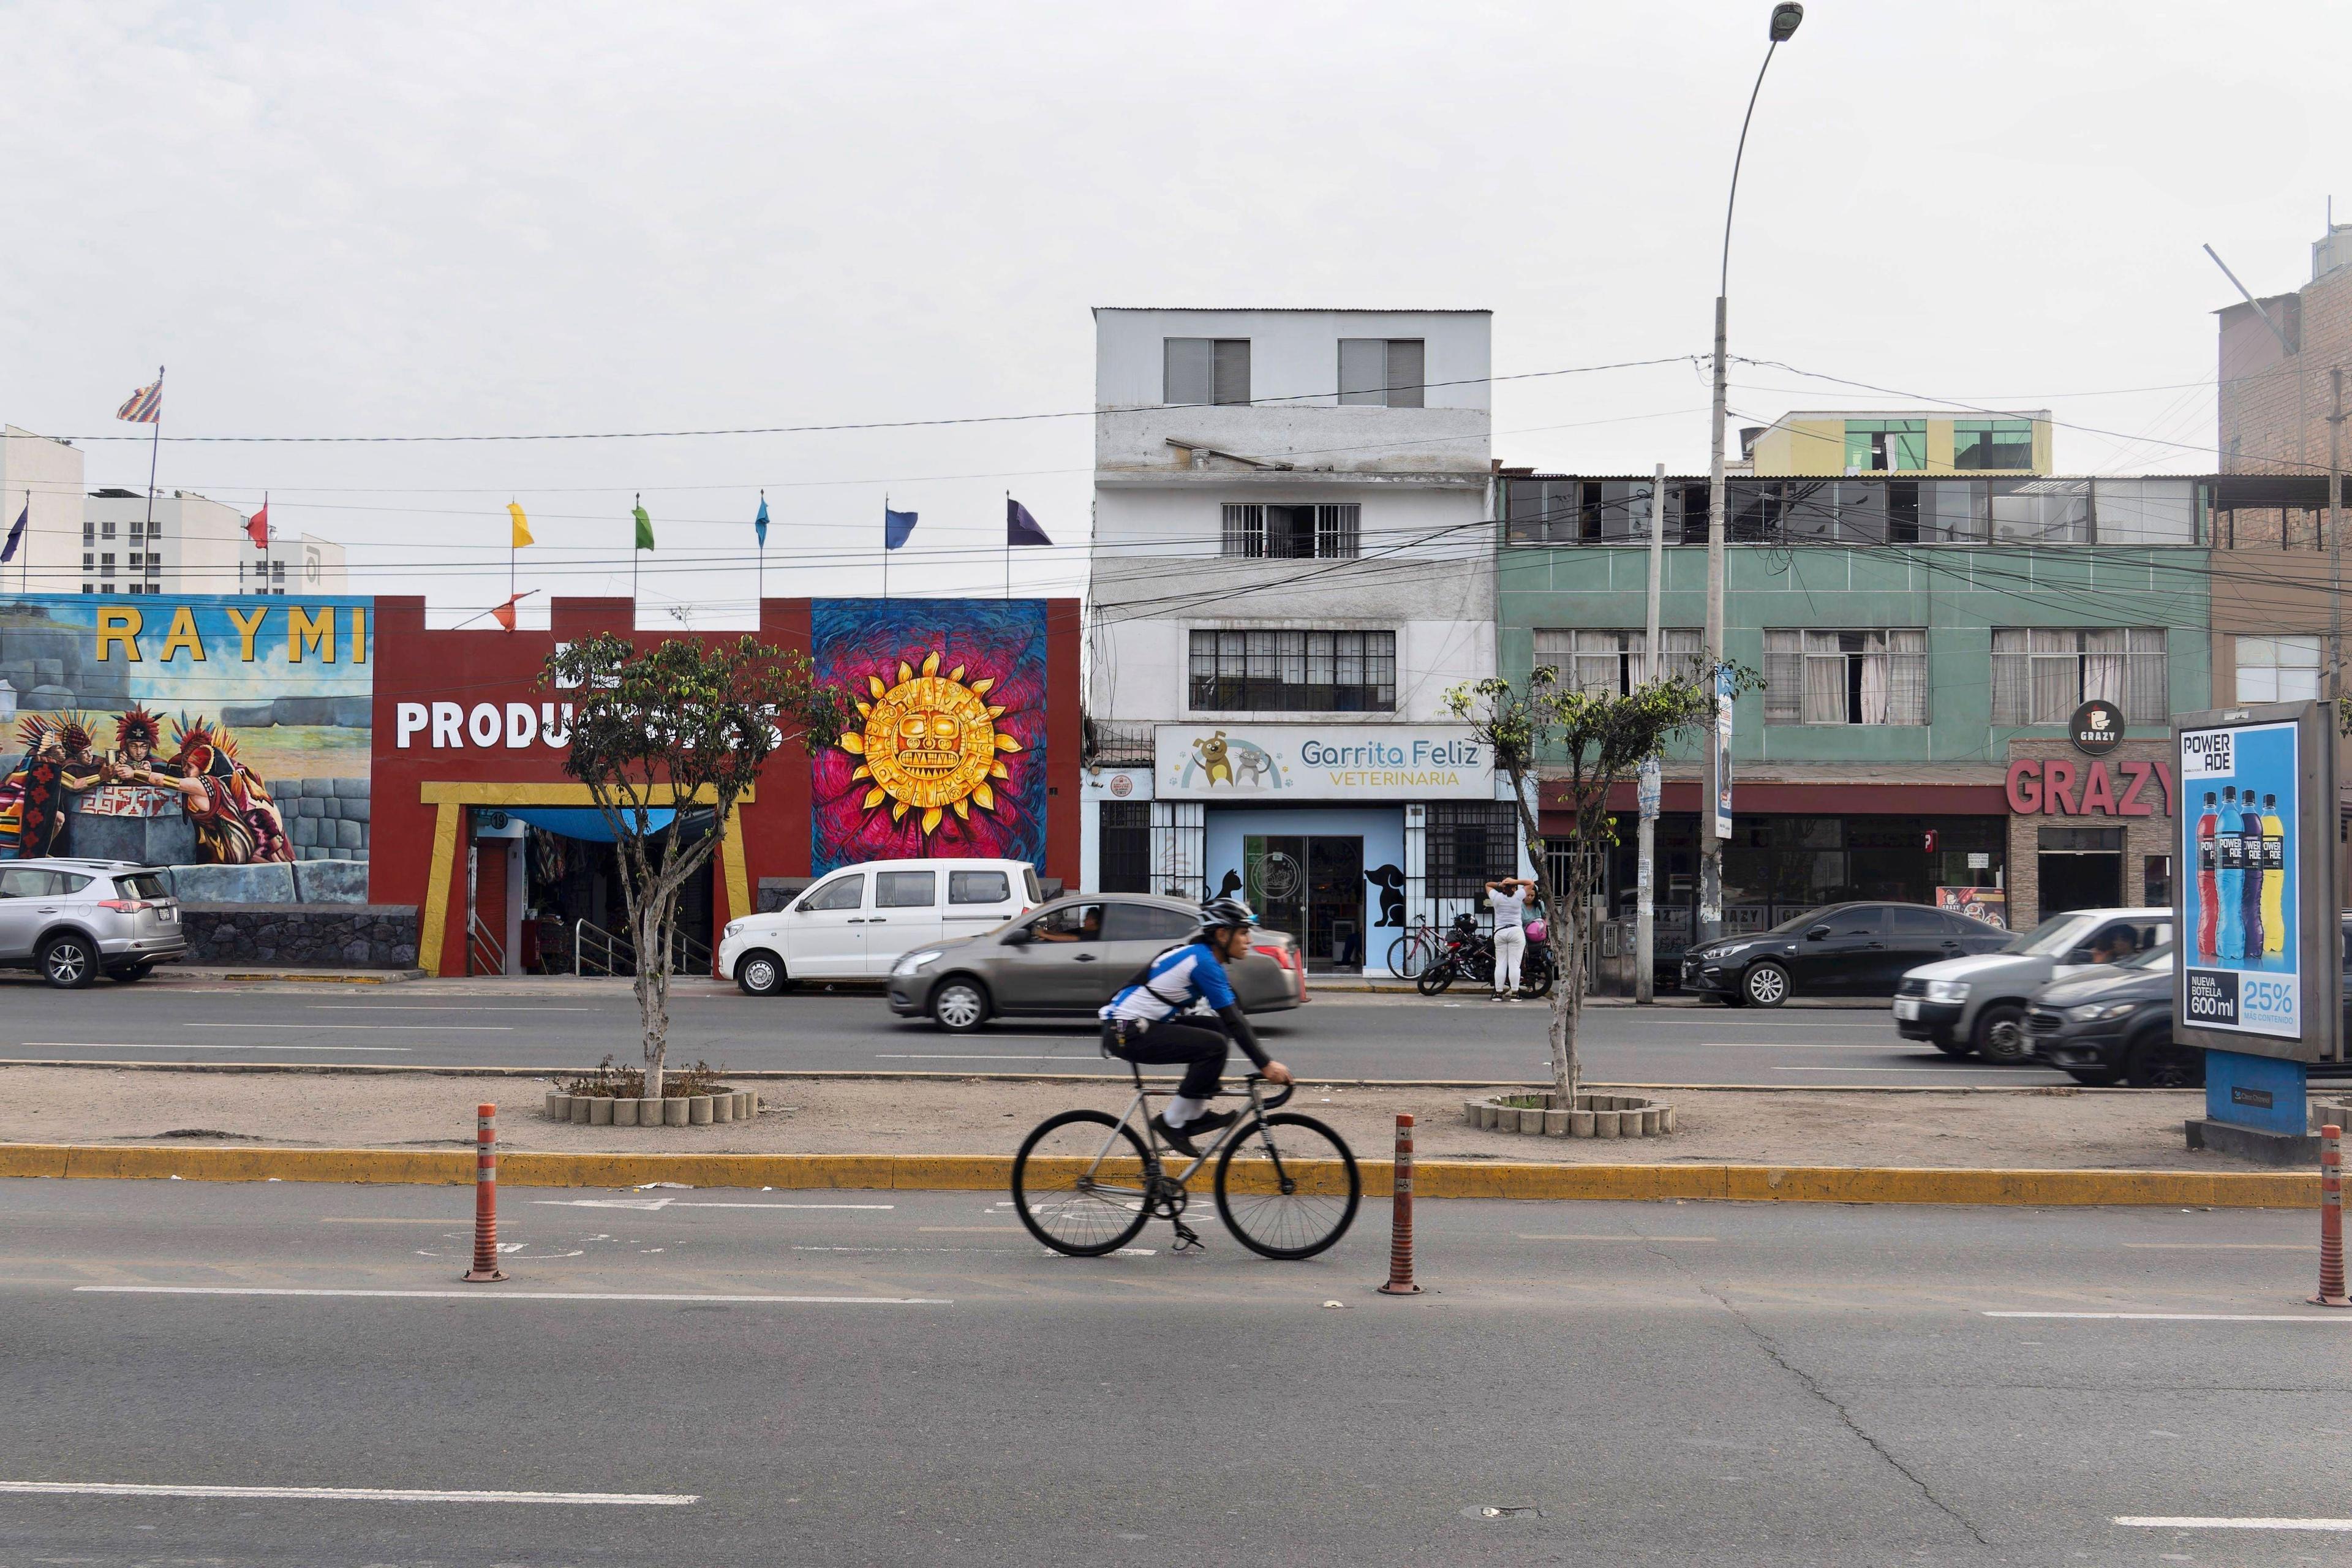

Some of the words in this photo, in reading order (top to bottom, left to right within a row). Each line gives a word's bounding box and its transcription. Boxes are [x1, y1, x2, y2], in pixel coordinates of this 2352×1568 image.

[97, 606, 366, 663] RAYMI
[2080, 731, 2115, 741] GRAZY
[2184, 733, 2230, 755] POWER
[1301, 740, 1404, 766] Garrita
[1412, 740, 1479, 765] Feliz
[2205, 752, 2231, 771] ADE
[1329, 772, 1460, 786] VETERINARIA
[493, 813, 505, 827] 19
[2200, 842, 2215, 851] POW
[2219, 838, 2242, 848] POWER
[2244, 841, 2261, 850] OWER
[2263, 842, 2281, 851] OWER
[2230, 848, 2242, 858] ADE
[2191, 976, 2215, 987] NUEVA
[2191, 986, 2222, 997] BOTELLA
[2244, 981, 2293, 1014] 25%
[2191, 996, 2216, 1015] 600
[2218, 998, 2233, 1017] ml
[2244, 1011, 2257, 1020] MÁS
[2258, 1014, 2294, 1025] CONTENIDO
